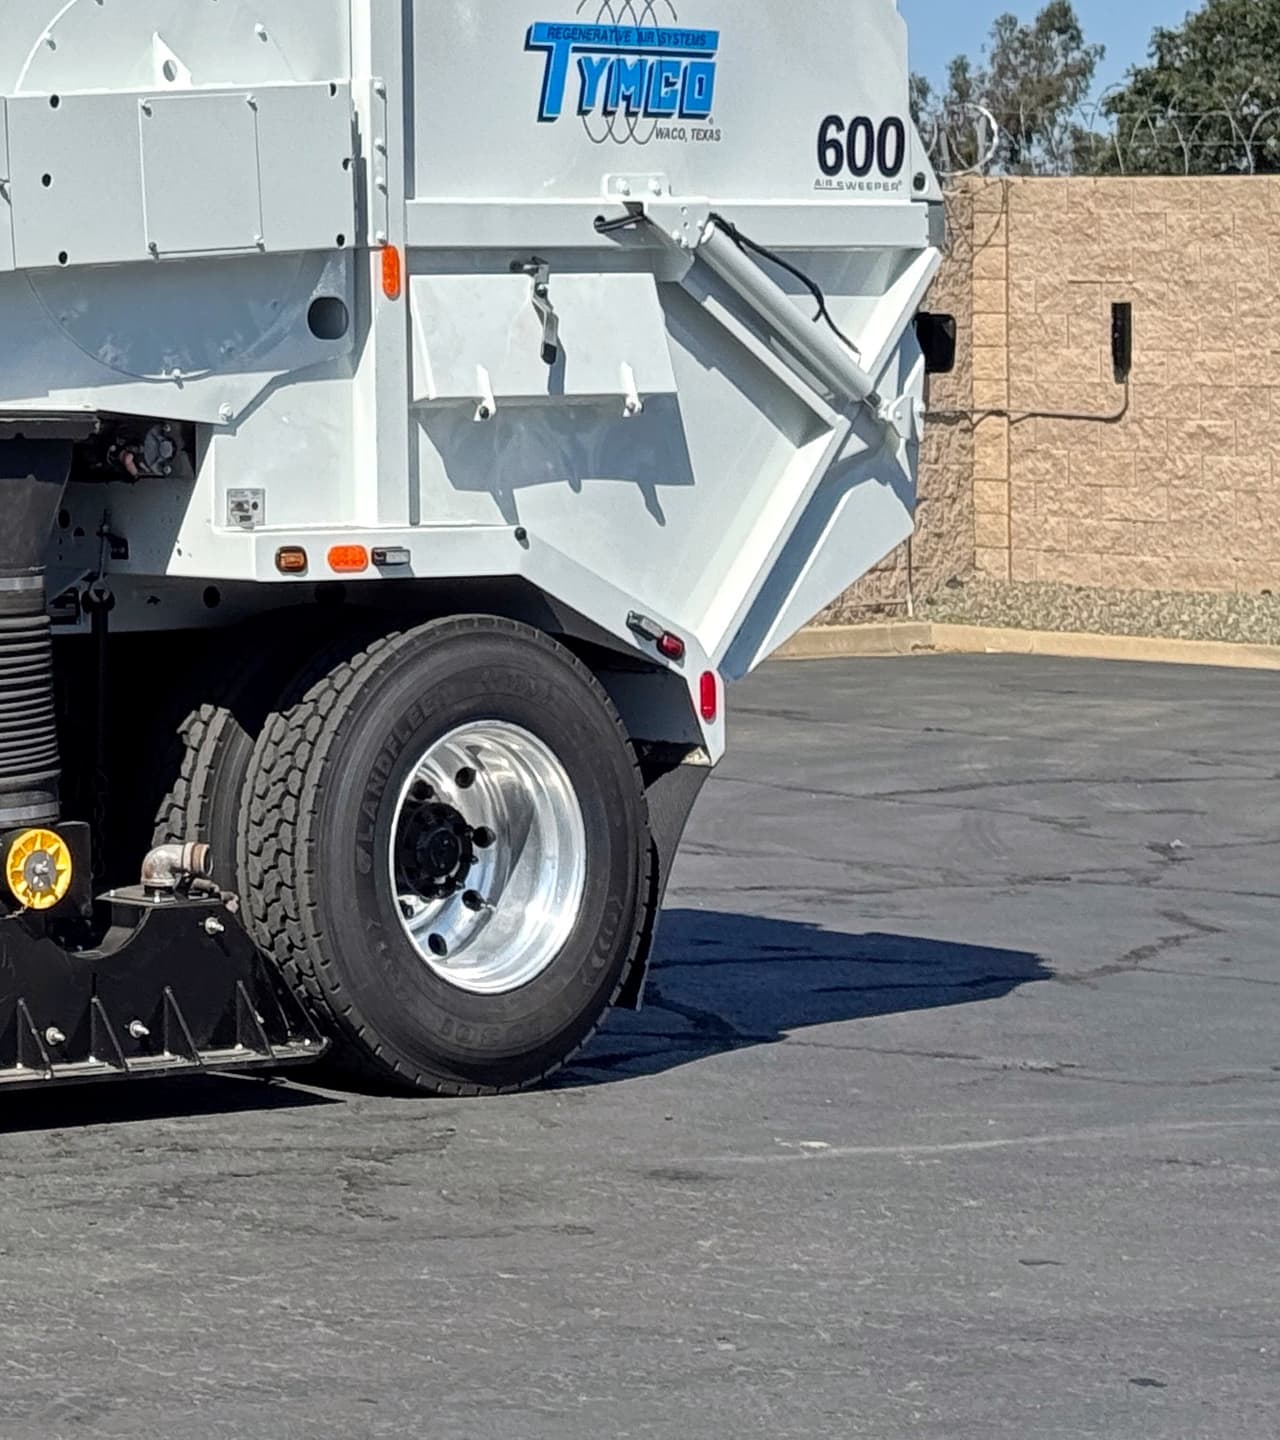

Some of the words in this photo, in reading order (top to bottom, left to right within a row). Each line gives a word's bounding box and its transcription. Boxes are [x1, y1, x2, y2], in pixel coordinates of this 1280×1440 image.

[547, 27, 631, 44] REGENERATIVE
[637, 32, 655, 44] AIR
[659, 32, 707, 46] SYSTEMS
[525, 21, 720, 123] TYMCO
[656, 128, 687, 143] WACO,
[691, 128, 721, 142] TEXAS
[817, 114, 905, 178] 600
[814, 179, 833, 188] AIR
